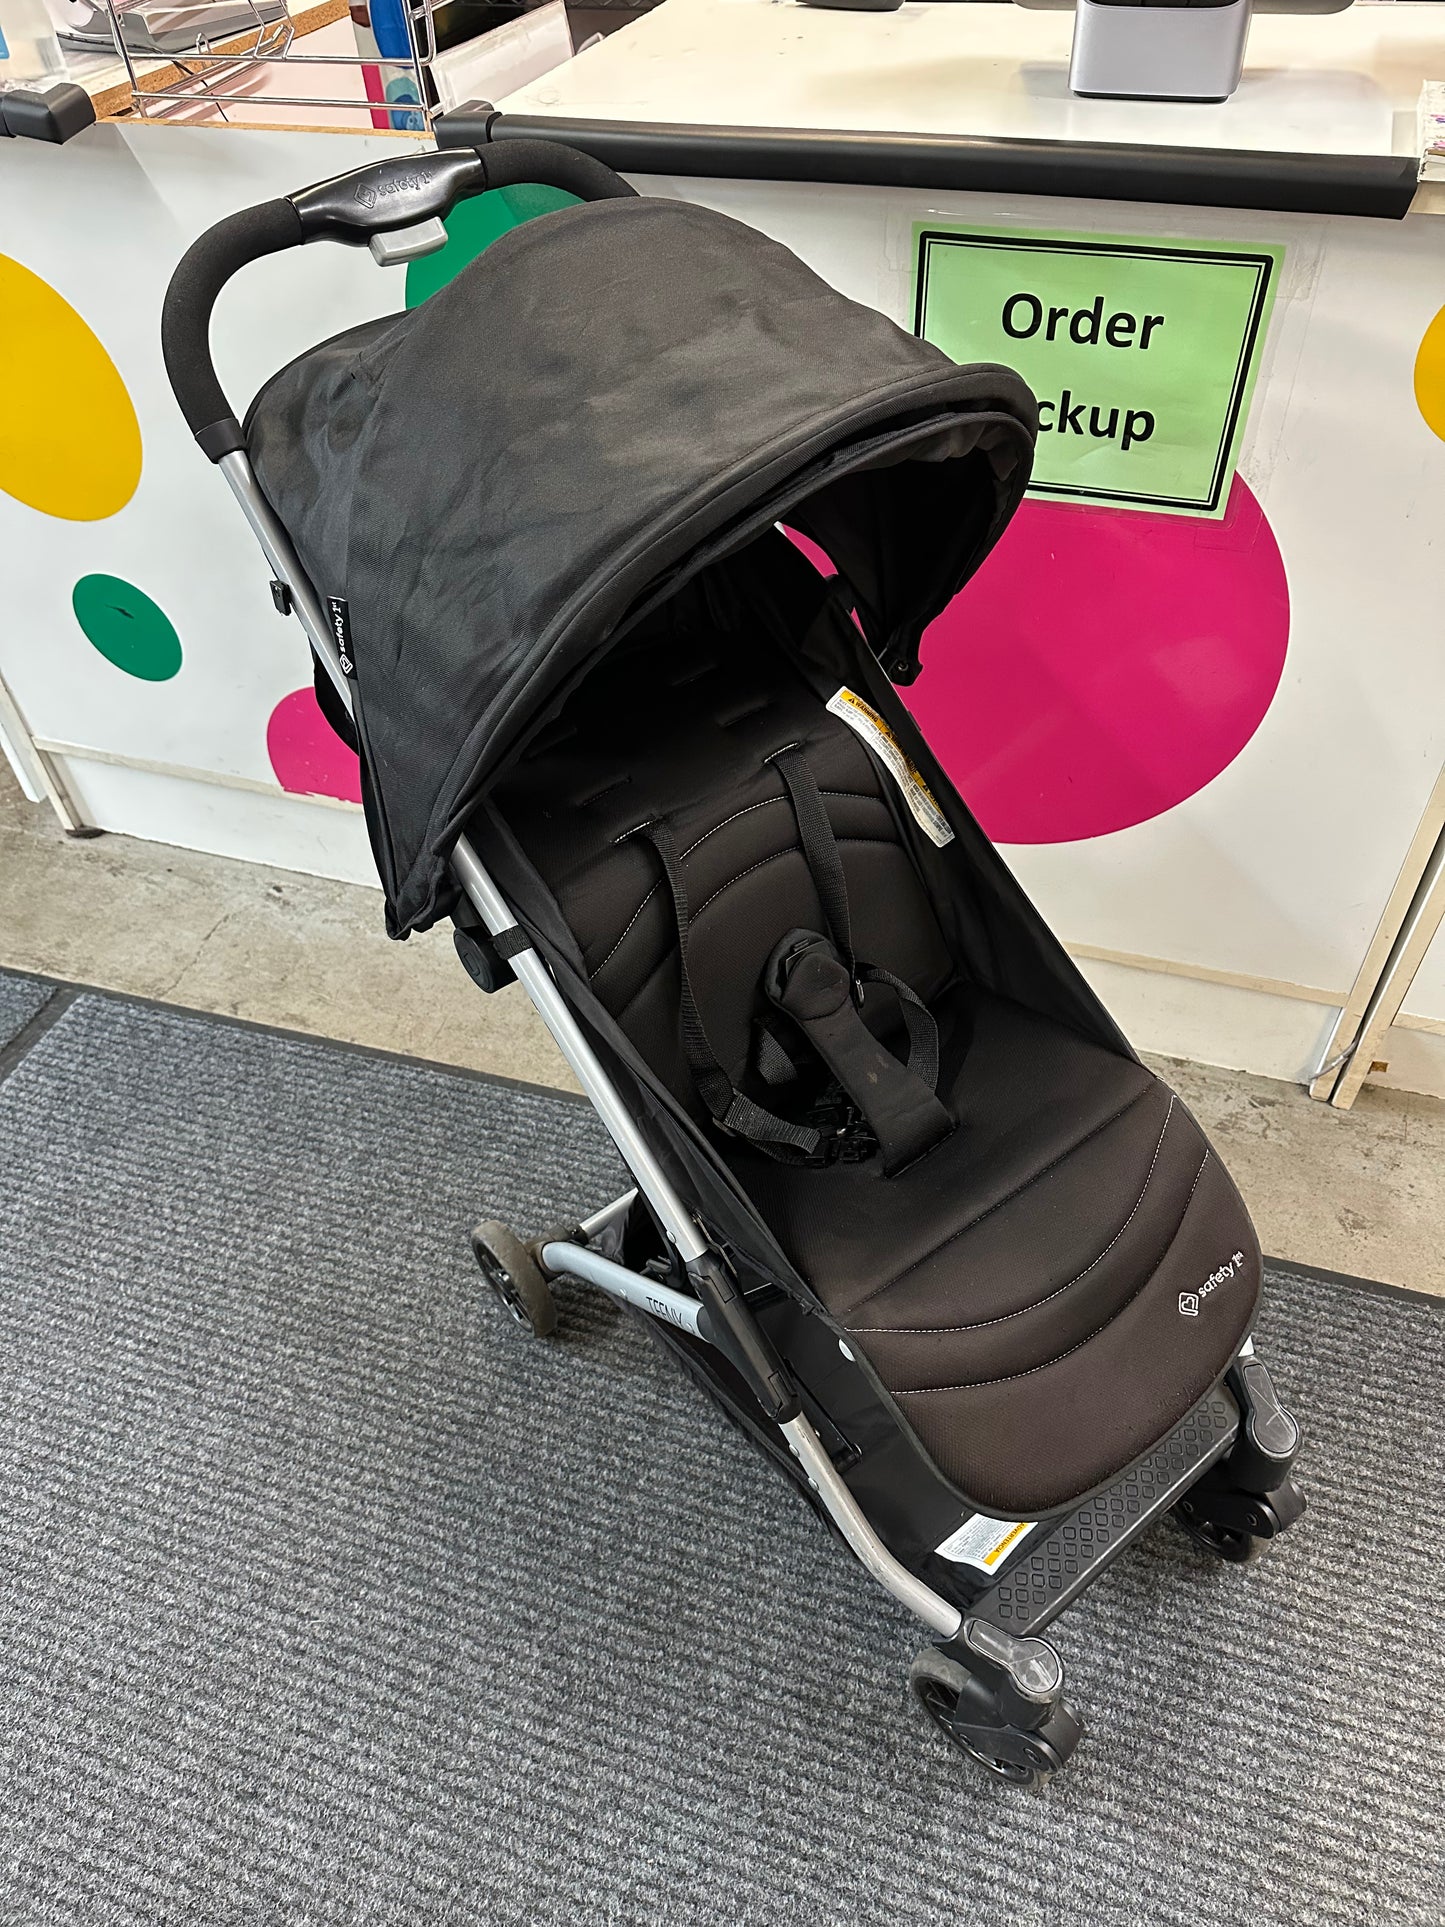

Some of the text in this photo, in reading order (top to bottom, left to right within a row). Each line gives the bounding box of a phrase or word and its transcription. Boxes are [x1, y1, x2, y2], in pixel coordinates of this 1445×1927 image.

[1002, 293, 1165, 350] Order
[1038, 390, 1155, 451] ckup
[334, 613, 346, 653] safety
[855, 701, 879, 723] WARNING
[1198, 1262, 1234, 1298] safety
